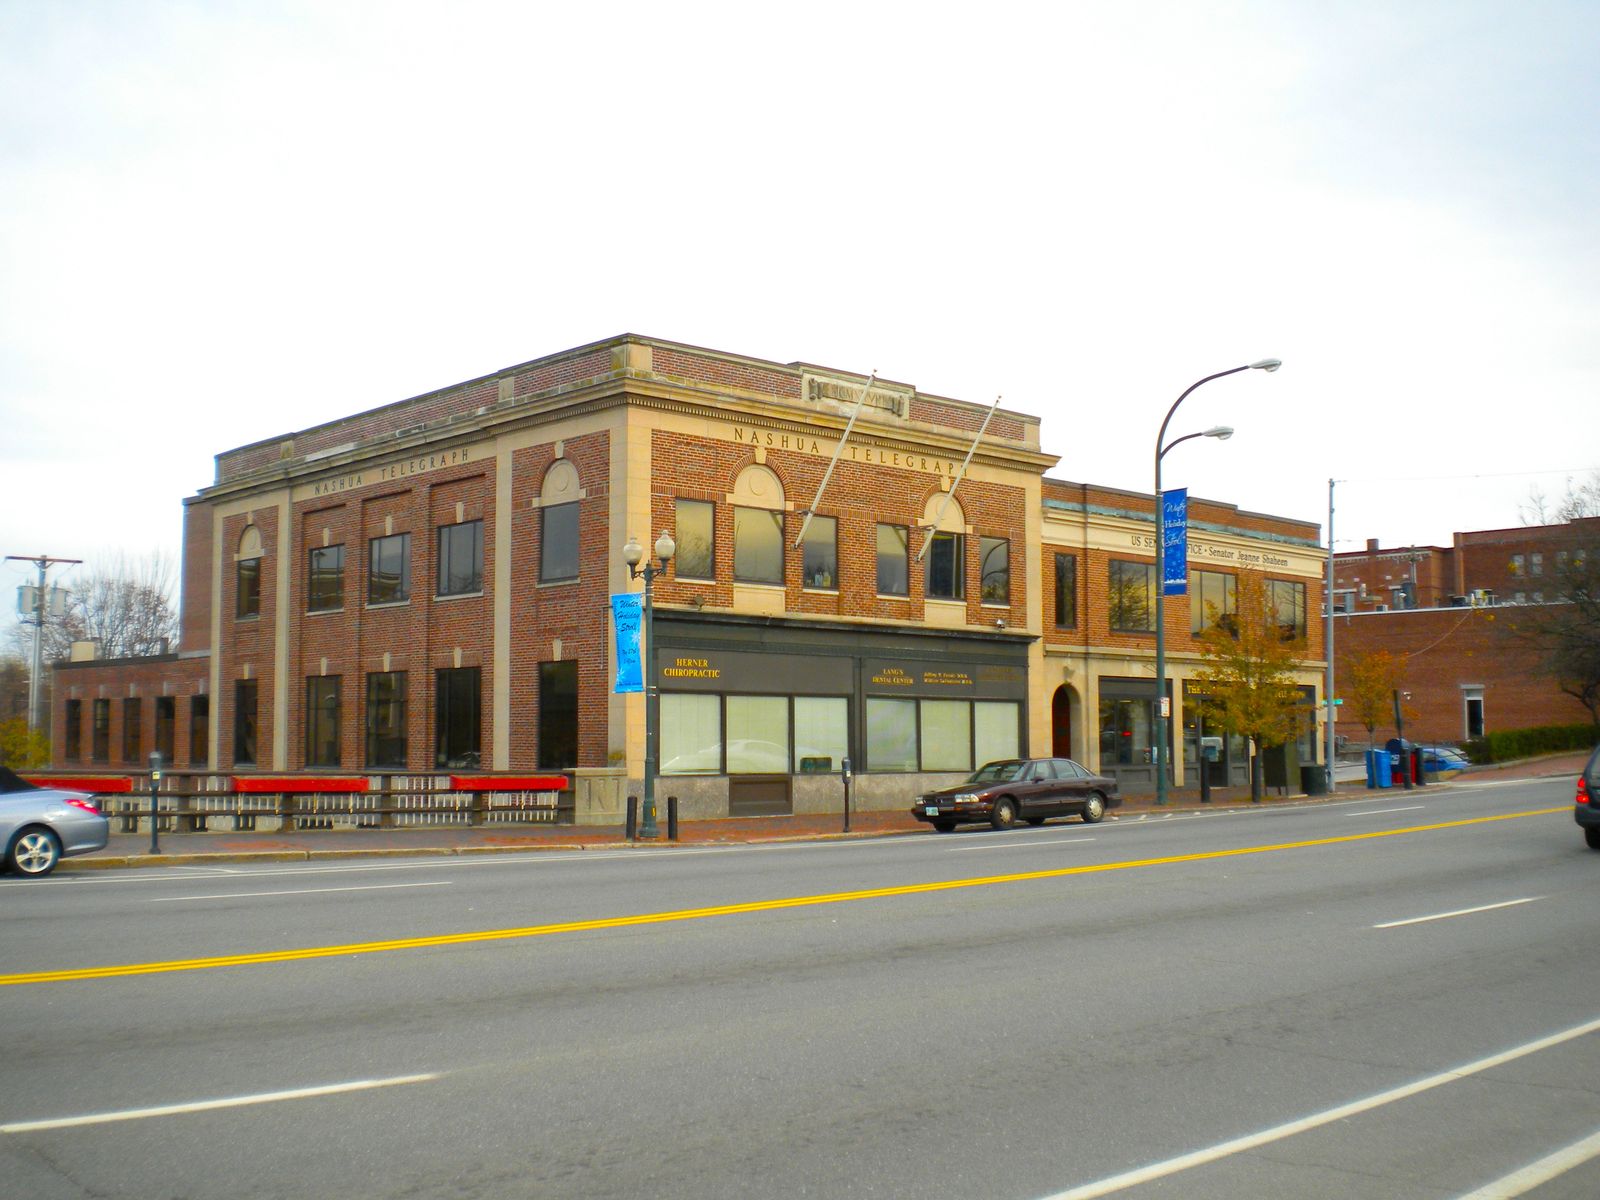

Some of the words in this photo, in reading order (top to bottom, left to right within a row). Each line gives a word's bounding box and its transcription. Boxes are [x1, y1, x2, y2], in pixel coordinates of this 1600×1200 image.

[734, 427, 820, 453] NASHUA
[314, 475, 362, 495] NASHUA
[381, 449, 468, 479] TELEGRAPH
[1164, 518, 1186, 529] Holiday
[1131, 535, 1141, 547] US
[1208, 546, 1234, 560] Senator
[1236, 550, 1260, 563] Jeanne
[1262, 554, 1288, 567] Shaheen
[676, 658, 709, 667] HERNER
[663, 667, 721, 678] CHIROPRACTIC
[893, 677, 914, 685] CENTER
